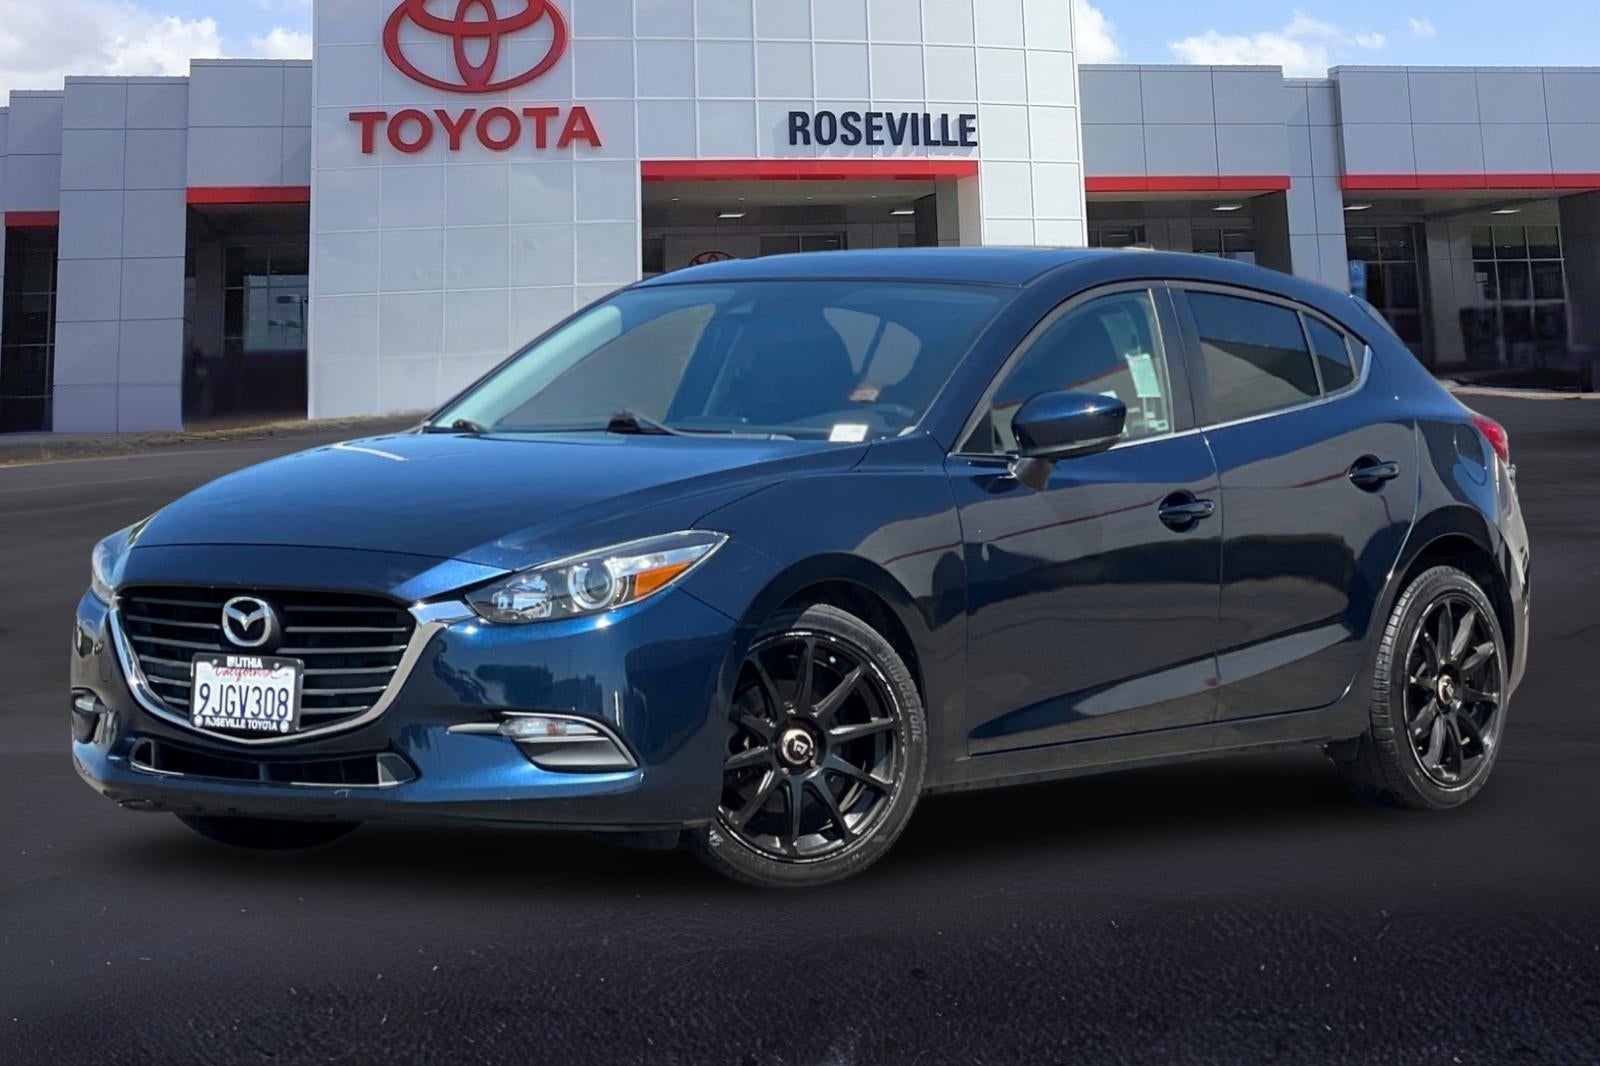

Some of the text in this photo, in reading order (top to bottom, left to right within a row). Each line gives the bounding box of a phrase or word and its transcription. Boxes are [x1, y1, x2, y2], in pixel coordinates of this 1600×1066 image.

[349, 106, 602, 154] TOYOTA
[788, 111, 977, 147] ROSEVILLE
[235, 656, 263, 669] LITHIA
[199, 683, 289, 720] 9JGV308
[205, 717, 278, 731] ROSEVILLE TOYOTA
